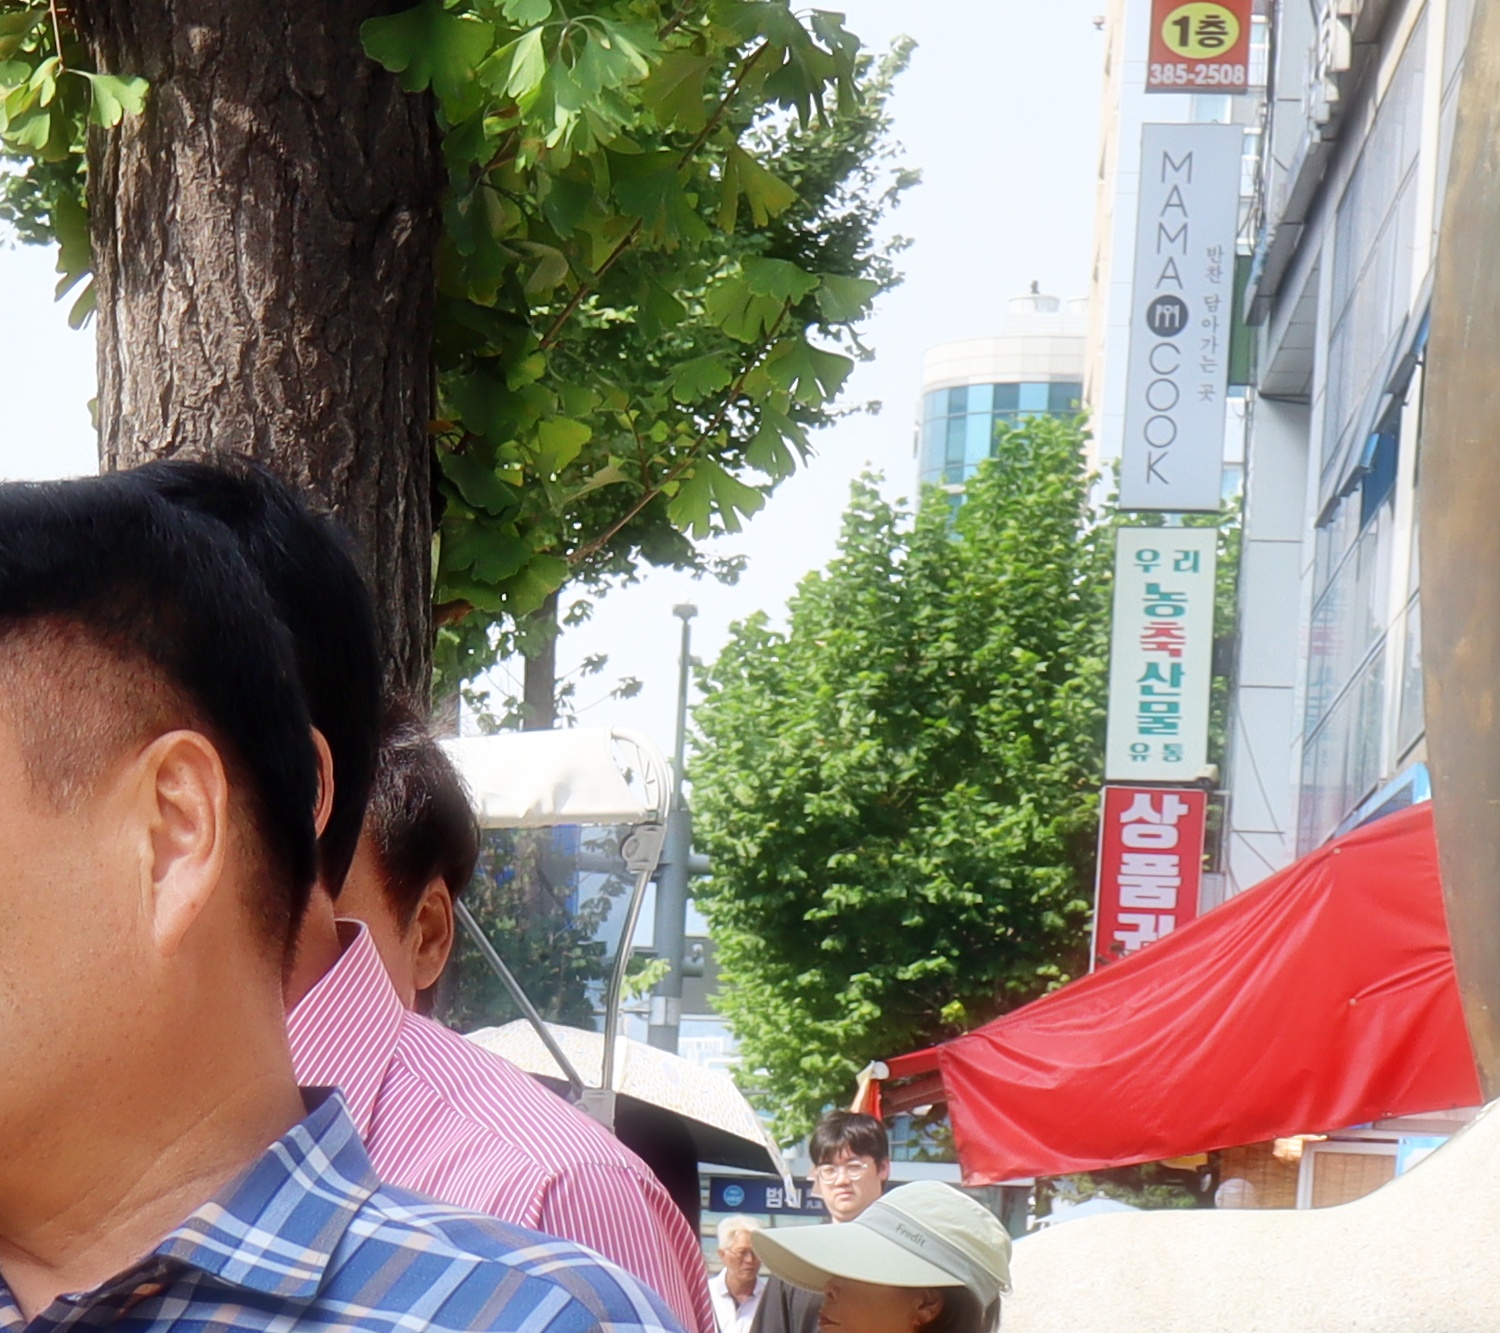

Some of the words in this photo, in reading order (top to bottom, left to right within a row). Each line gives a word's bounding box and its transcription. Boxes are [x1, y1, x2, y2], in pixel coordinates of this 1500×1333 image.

[1171, 14, 1229, 48] 1층
[1149, 63, 1245, 85] 385-2508
[1155, 151, 1194, 290] MAMA
[1204, 245, 1225, 284] 반찬
[1197, 293, 1220, 374] 담아가는
[1196, 383, 1217, 402] 곳
[1143, 342, 1182, 485] COOK
[1134, 548, 1201, 574] 우리
[1136, 582, 1188, 736] 농축산물
[1128, 742, 1185, 763] 유통
